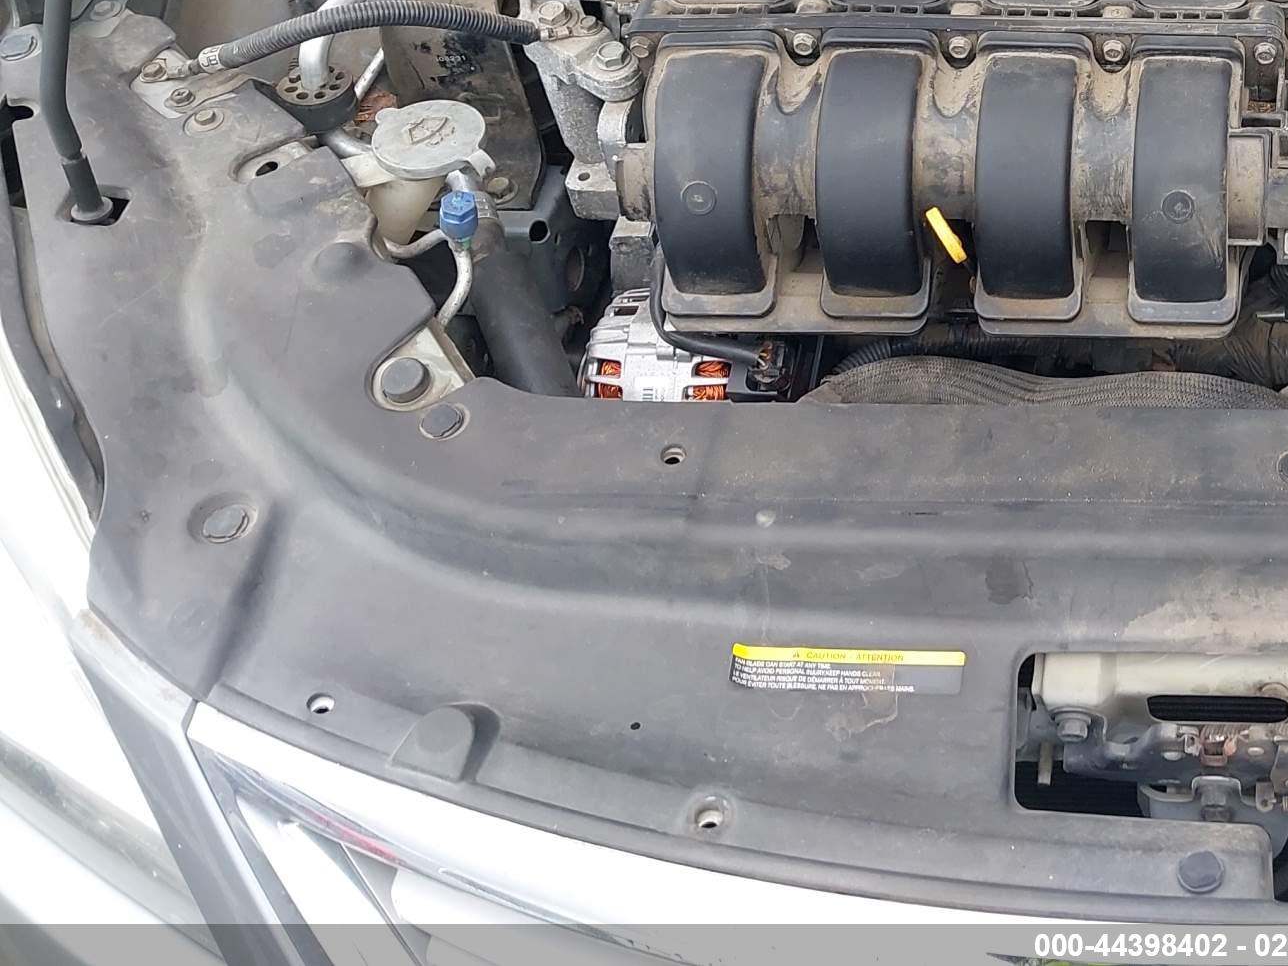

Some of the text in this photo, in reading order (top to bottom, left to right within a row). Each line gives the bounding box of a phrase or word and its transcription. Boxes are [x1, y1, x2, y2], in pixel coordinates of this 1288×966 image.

[806, 651, 847, 660] CAUTION
[856, 653, 904, 662] ATTENTION
[742, 665, 757, 673] HELP
[775, 667, 806, 675] PERSONAL
